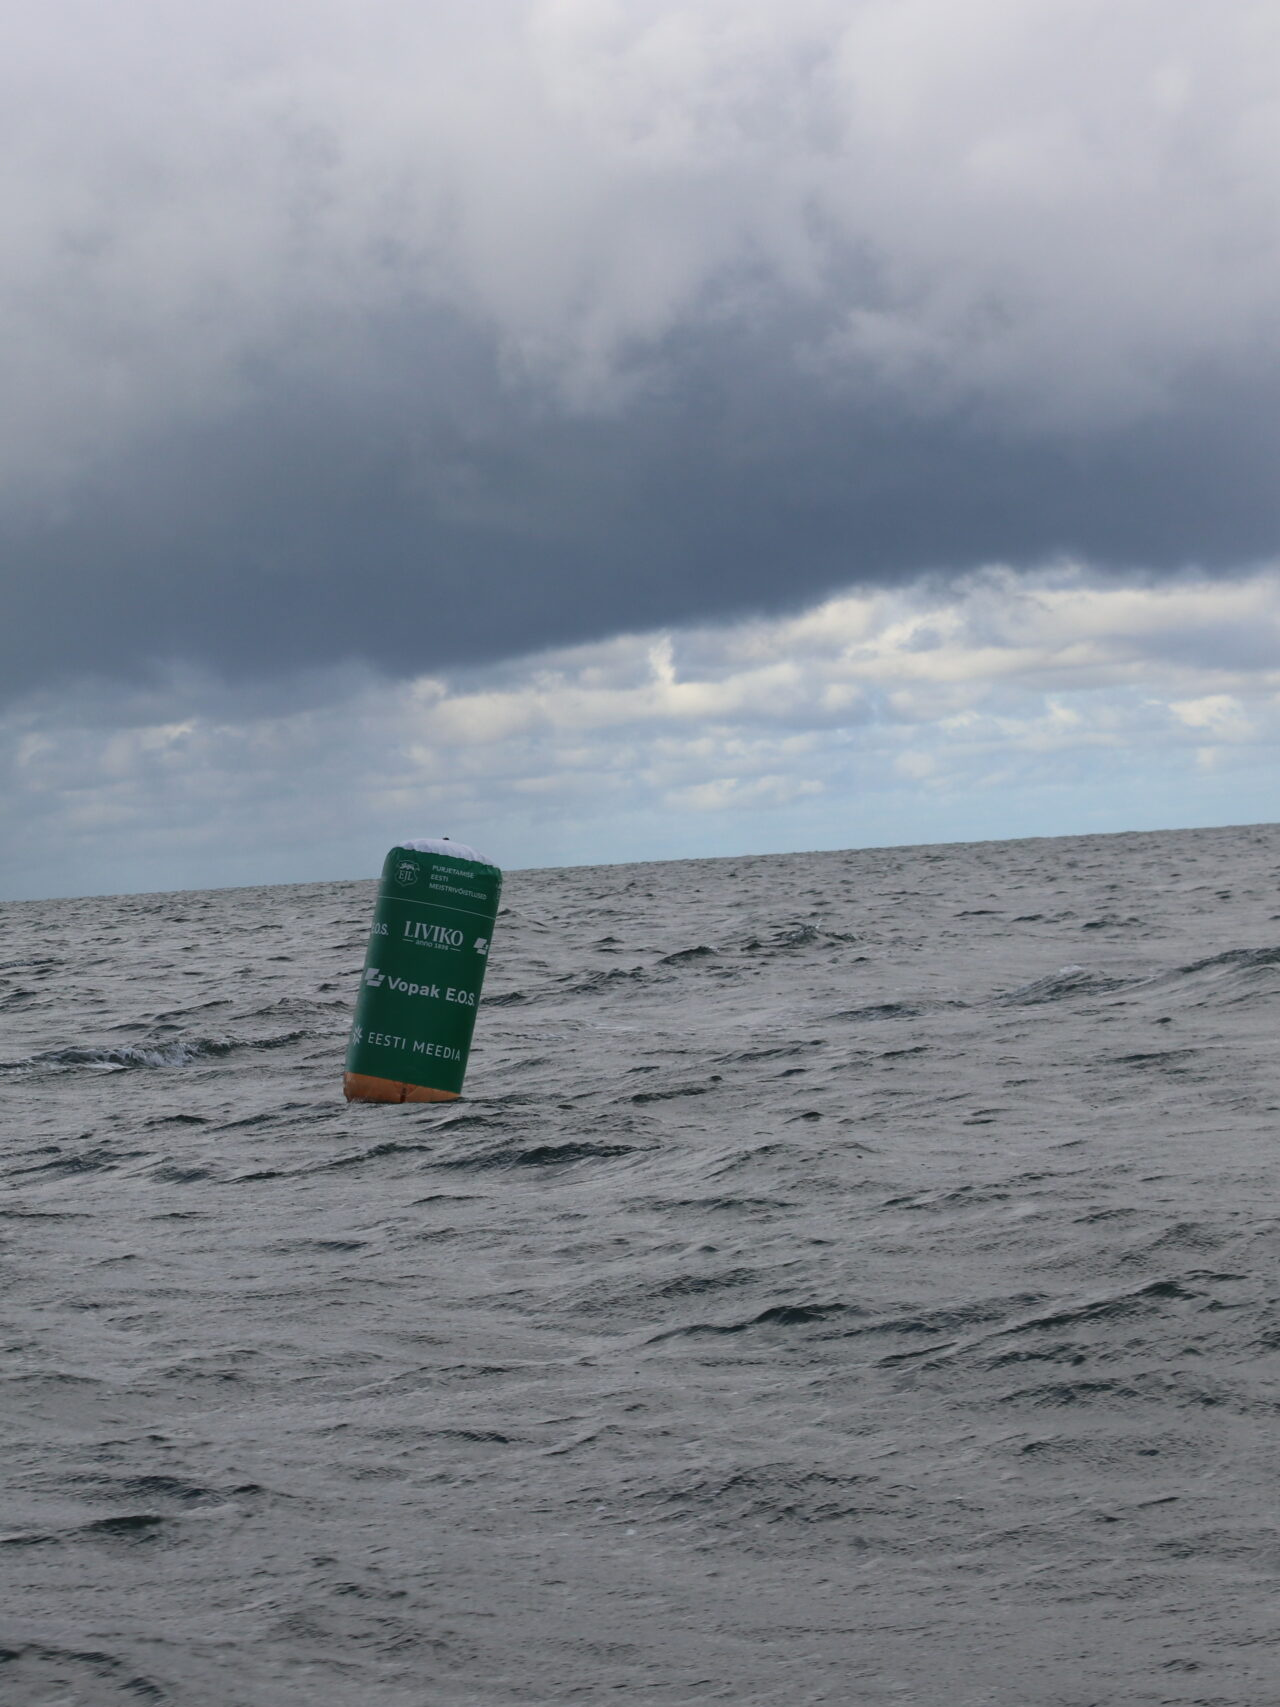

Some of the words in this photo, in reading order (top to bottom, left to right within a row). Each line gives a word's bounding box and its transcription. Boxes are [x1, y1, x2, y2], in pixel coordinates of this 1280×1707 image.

[430, 873, 449, 883] EESTI
[404, 920, 464, 947] LIVIKO
[415, 939, 433, 948] anno
[388, 975, 440, 998] Vopak
[368, 1031, 406, 1050] EESTI
[413, 1040, 461, 1062] MEEDIA
